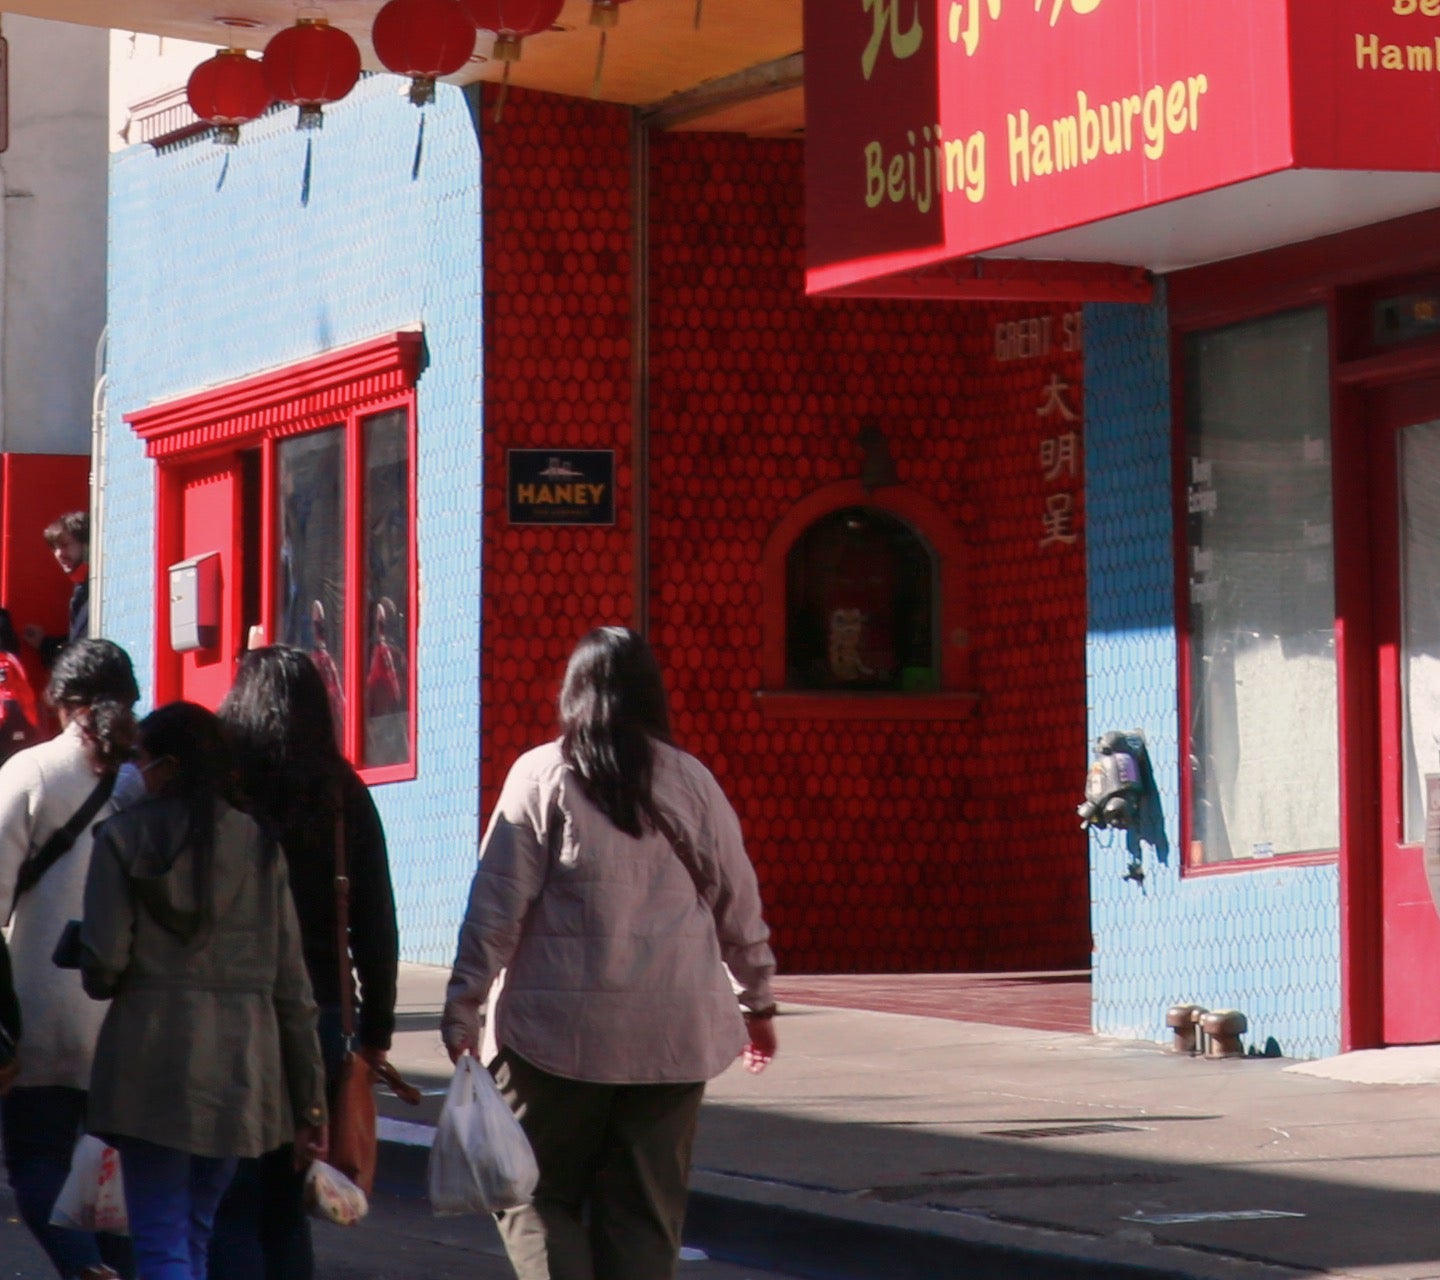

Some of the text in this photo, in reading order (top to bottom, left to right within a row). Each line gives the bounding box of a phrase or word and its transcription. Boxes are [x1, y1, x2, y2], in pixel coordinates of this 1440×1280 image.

[863, 69, 1209, 215] Beijing Hamburger
[995, 316, 1051, 362] GREAT
[516, 482, 606, 505] HANEY
